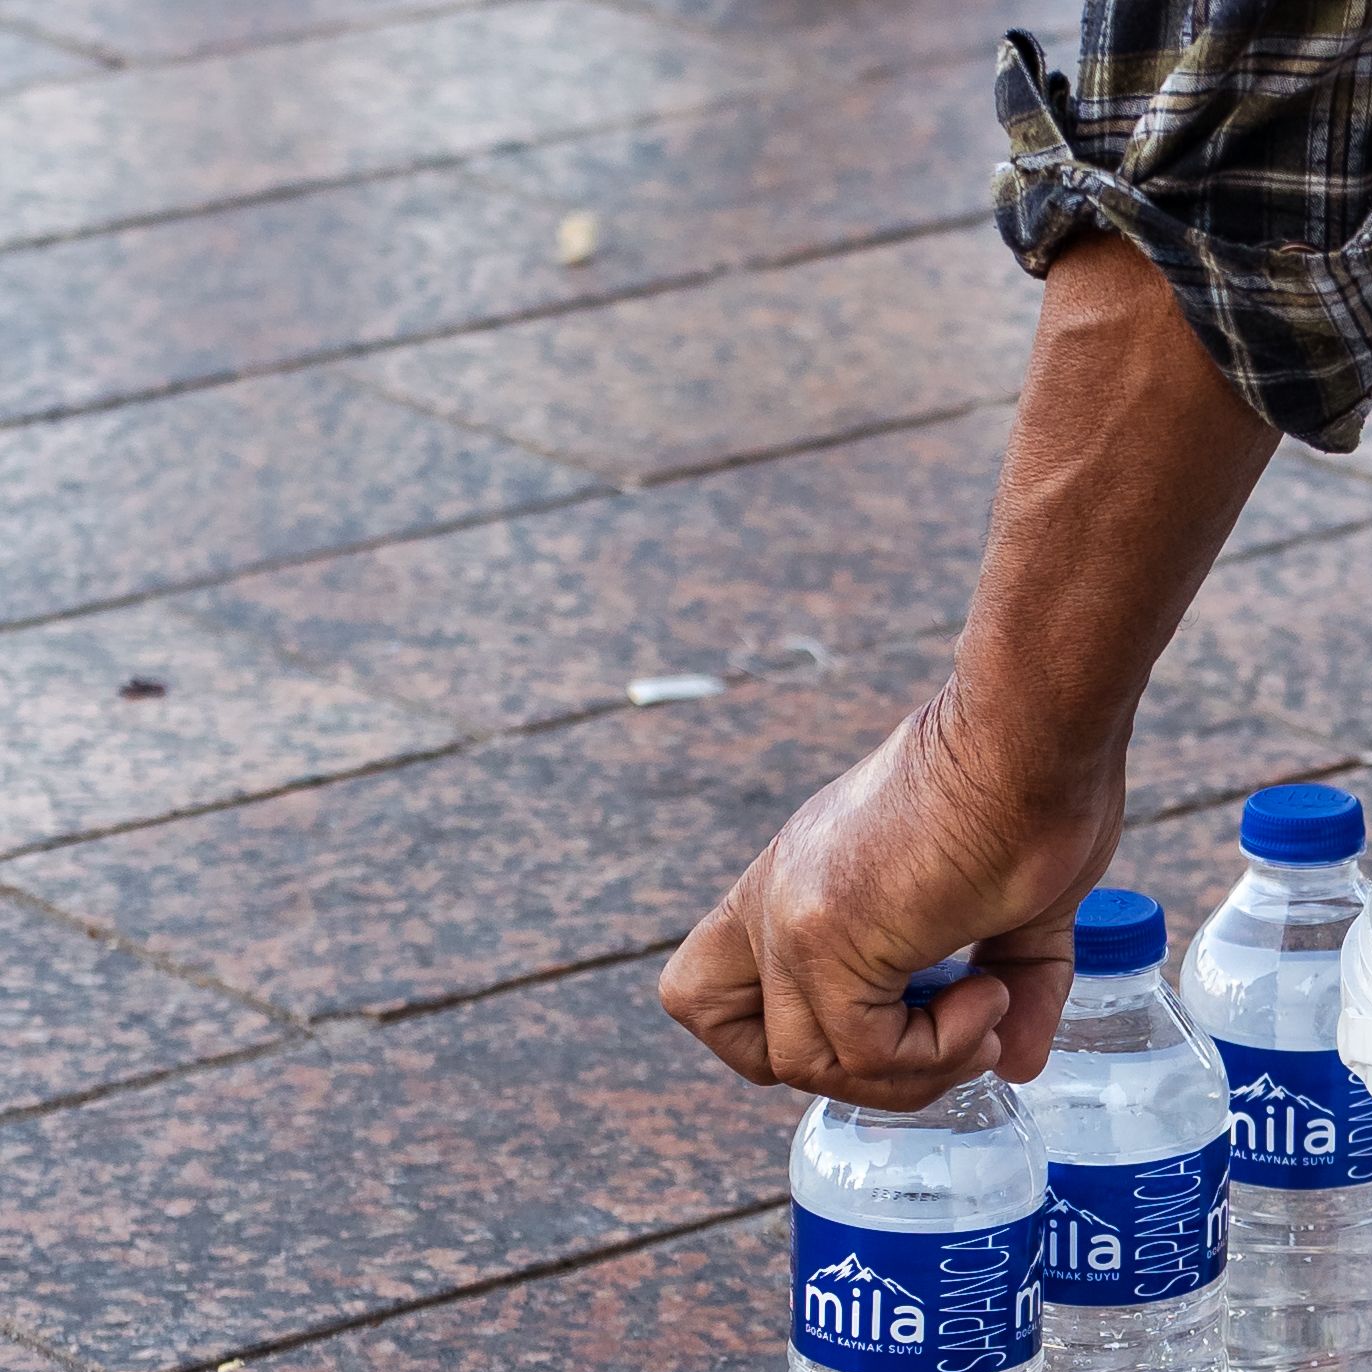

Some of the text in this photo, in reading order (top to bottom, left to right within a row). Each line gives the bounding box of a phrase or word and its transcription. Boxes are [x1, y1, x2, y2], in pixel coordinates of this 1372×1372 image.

[1251, 1152, 1297, 1166] KAYNAK
[1302, 1156, 1334, 1166] SUYU
[1049, 1220, 1121, 1271] ila
[1133, 1153, 1201, 1297] SAPANCA
[1043, 1268, 1120, 1282] AYNAK SUYU
[805, 1283, 925, 1344] mila
[805, 1323, 923, 1356] DOĞAL KAYNAK SUYU
